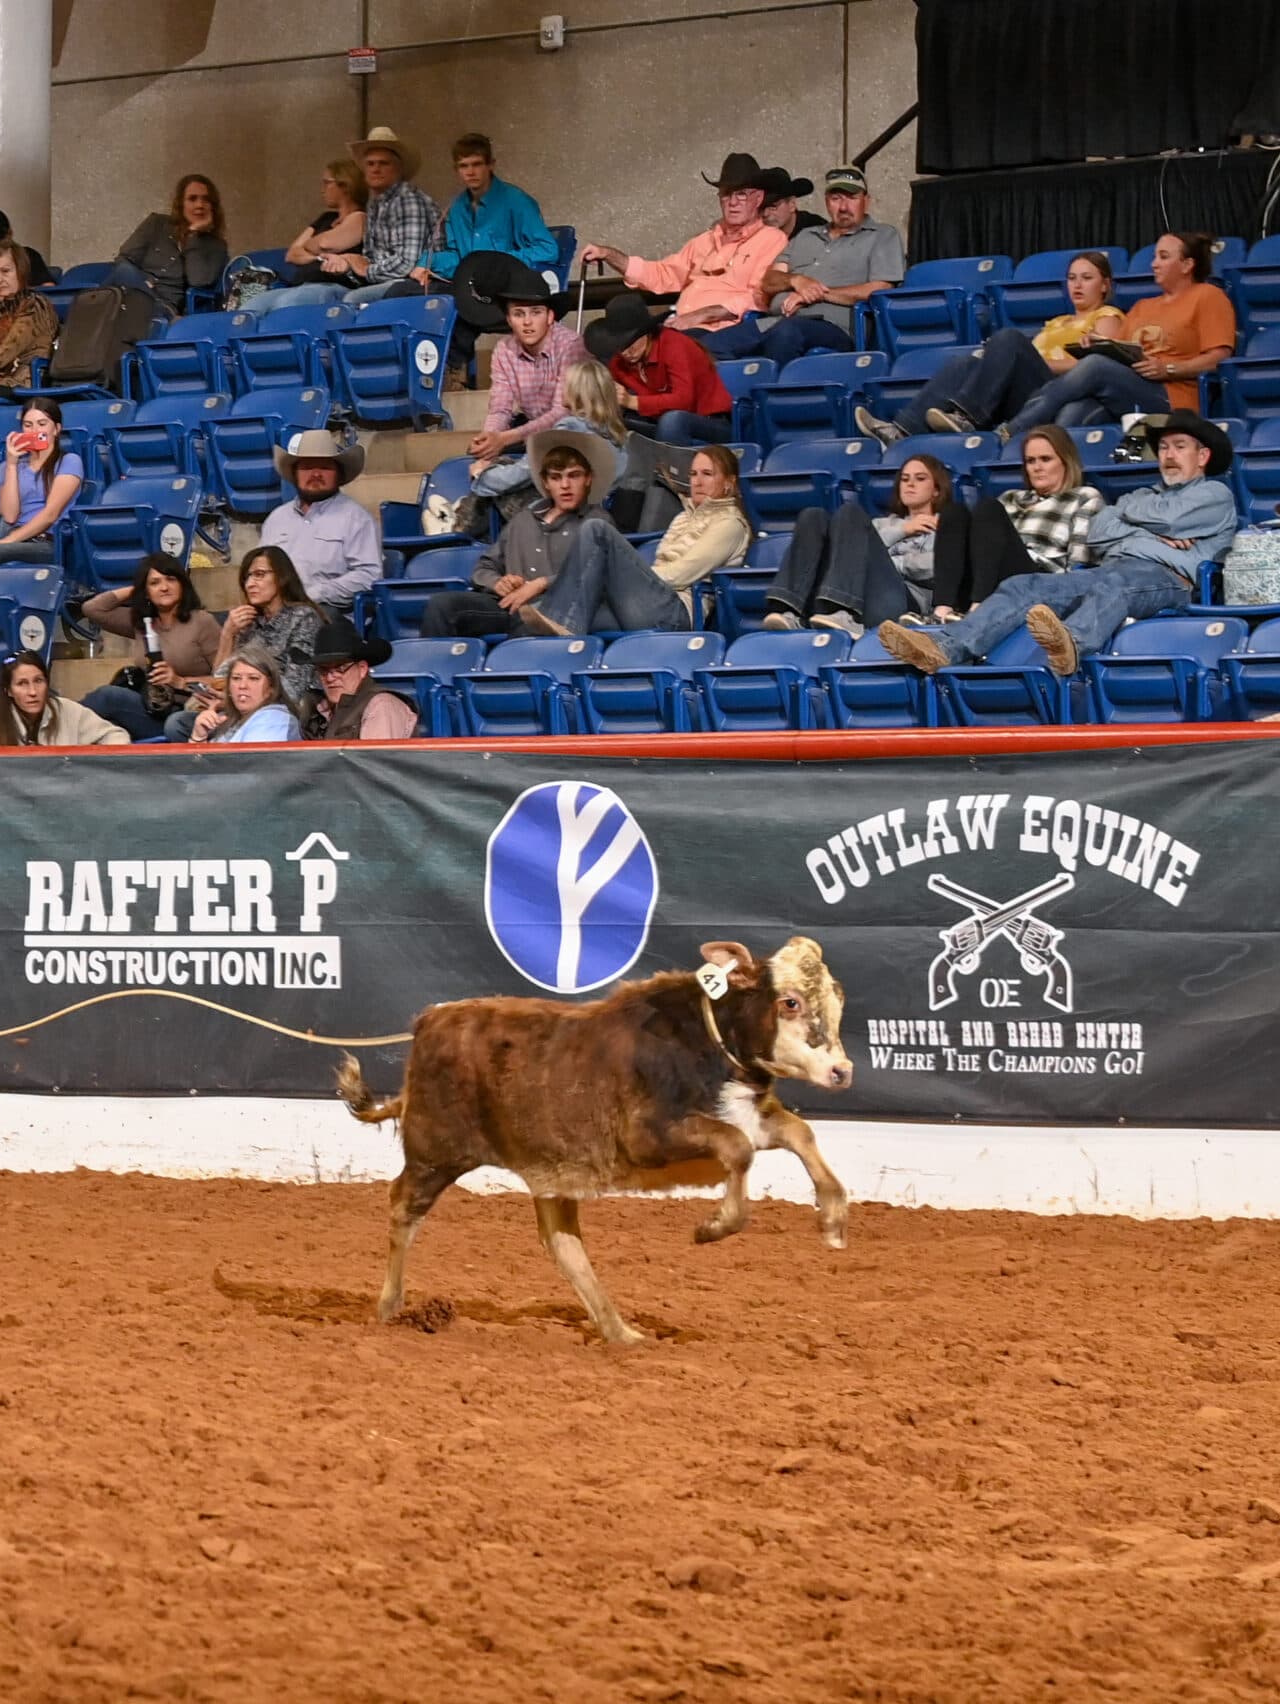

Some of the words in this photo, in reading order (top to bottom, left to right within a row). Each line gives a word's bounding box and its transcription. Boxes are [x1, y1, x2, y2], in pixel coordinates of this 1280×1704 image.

[805, 793, 1011, 905] OUTLAW
[1019, 794, 1201, 908] EQUINE
[23, 859, 277, 933] RAFTER
[299, 858, 338, 933] P
[24, 949, 268, 986] CONSTRUCTION
[278, 951, 338, 986] INC.
[867, 1019, 950, 1047] HOSPITAL
[961, 1020, 995, 1047] AND
[1006, 1021, 1064, 1048] REHAB
[1075, 1022, 1143, 1050] CENTER
